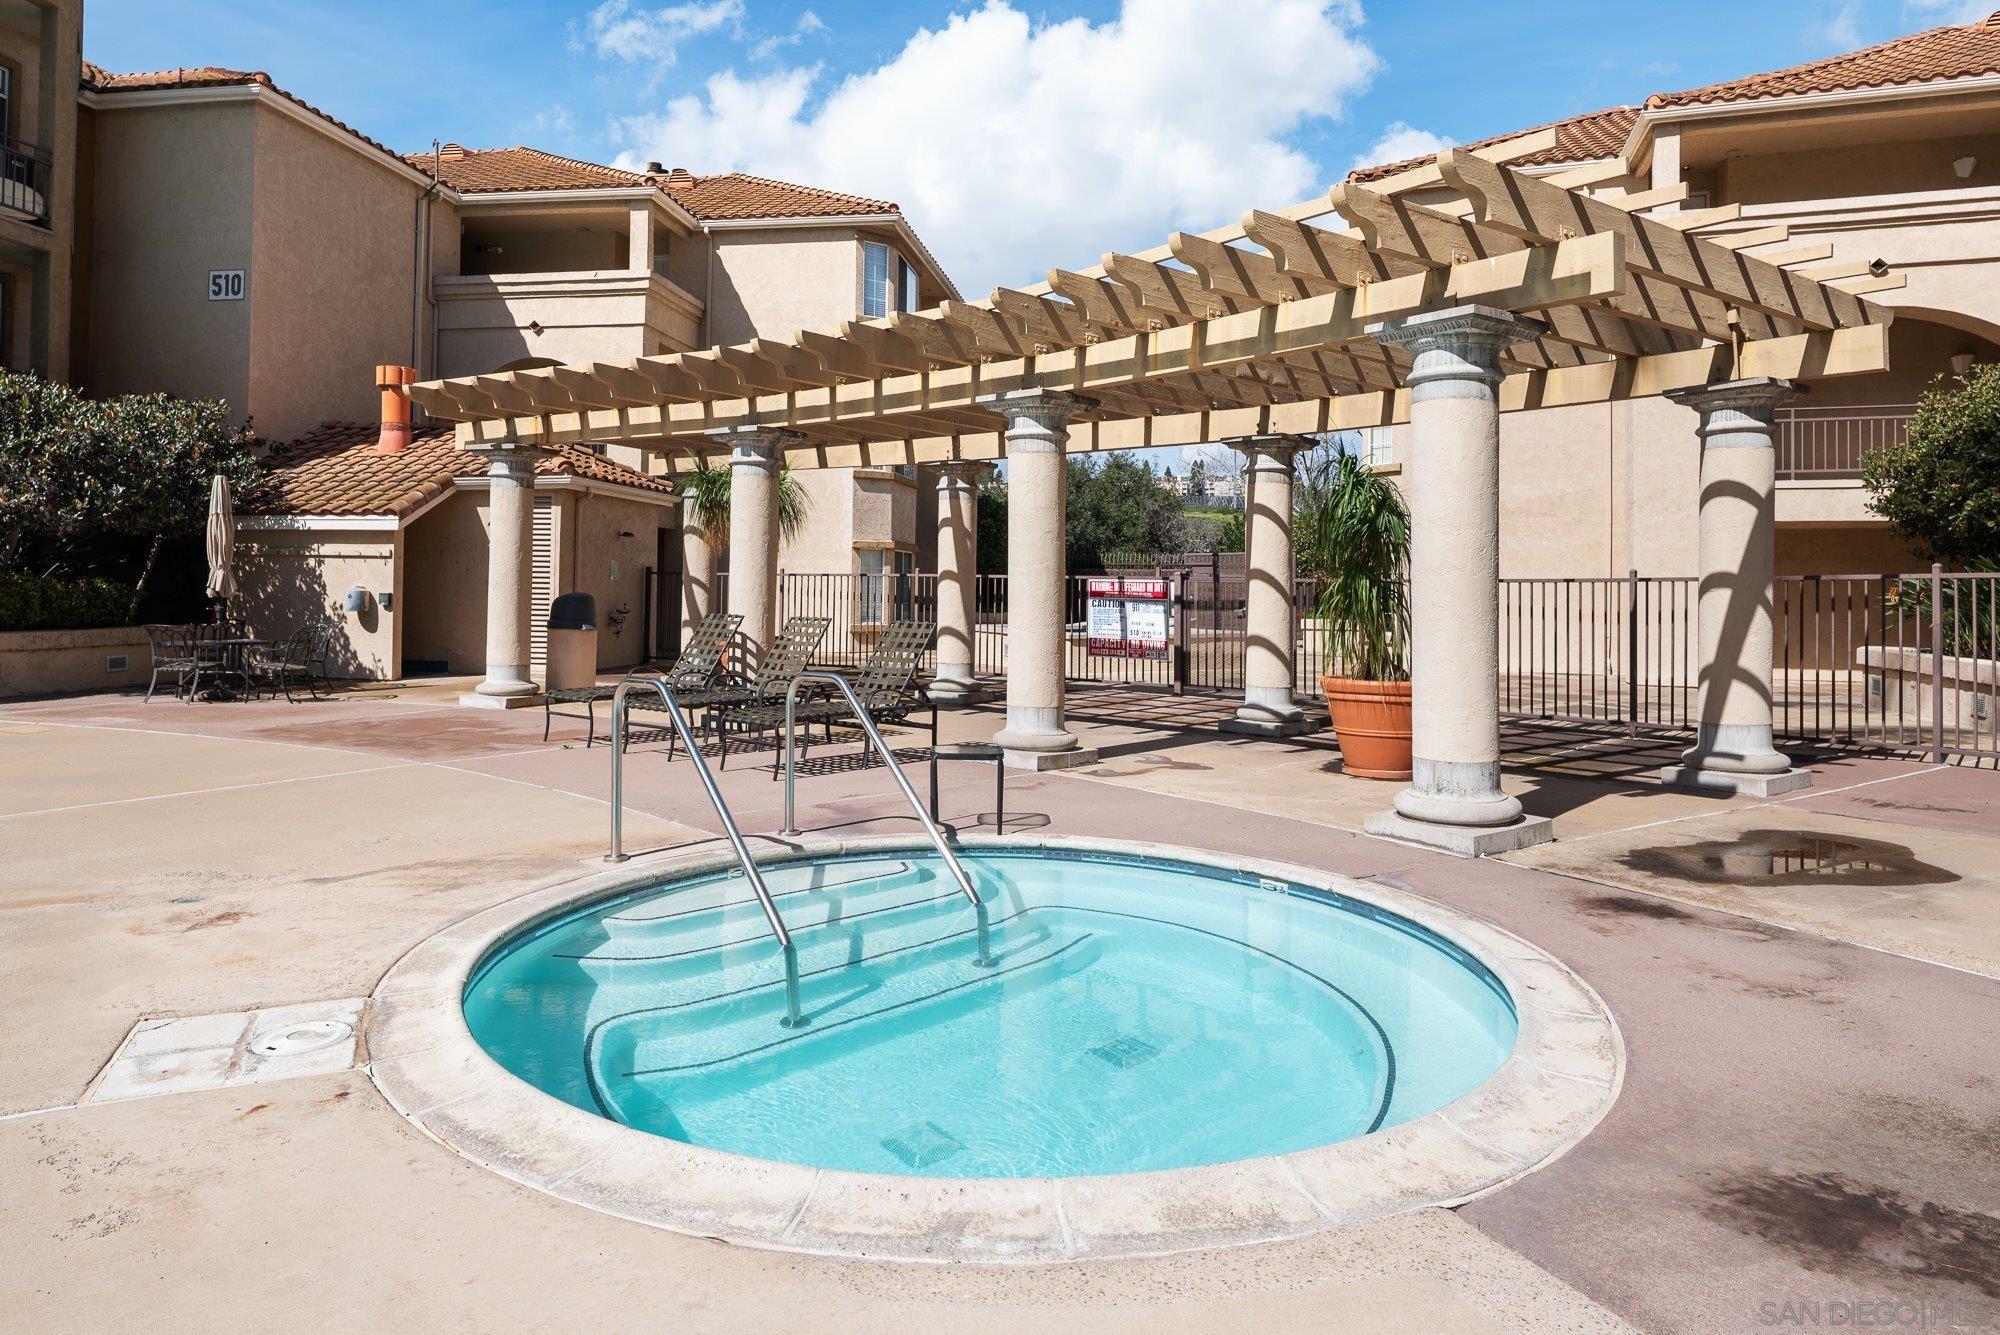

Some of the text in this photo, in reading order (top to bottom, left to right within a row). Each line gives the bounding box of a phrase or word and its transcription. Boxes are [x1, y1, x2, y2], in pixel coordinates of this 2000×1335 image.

[211, 273, 242, 297] 510
[1091, 599, 1125, 608] CAUTION
[1132, 603, 1140, 612] 911
[1091, 639, 1126, 648] CAPACITY
[1130, 640, 1166, 650] NO DIVING
